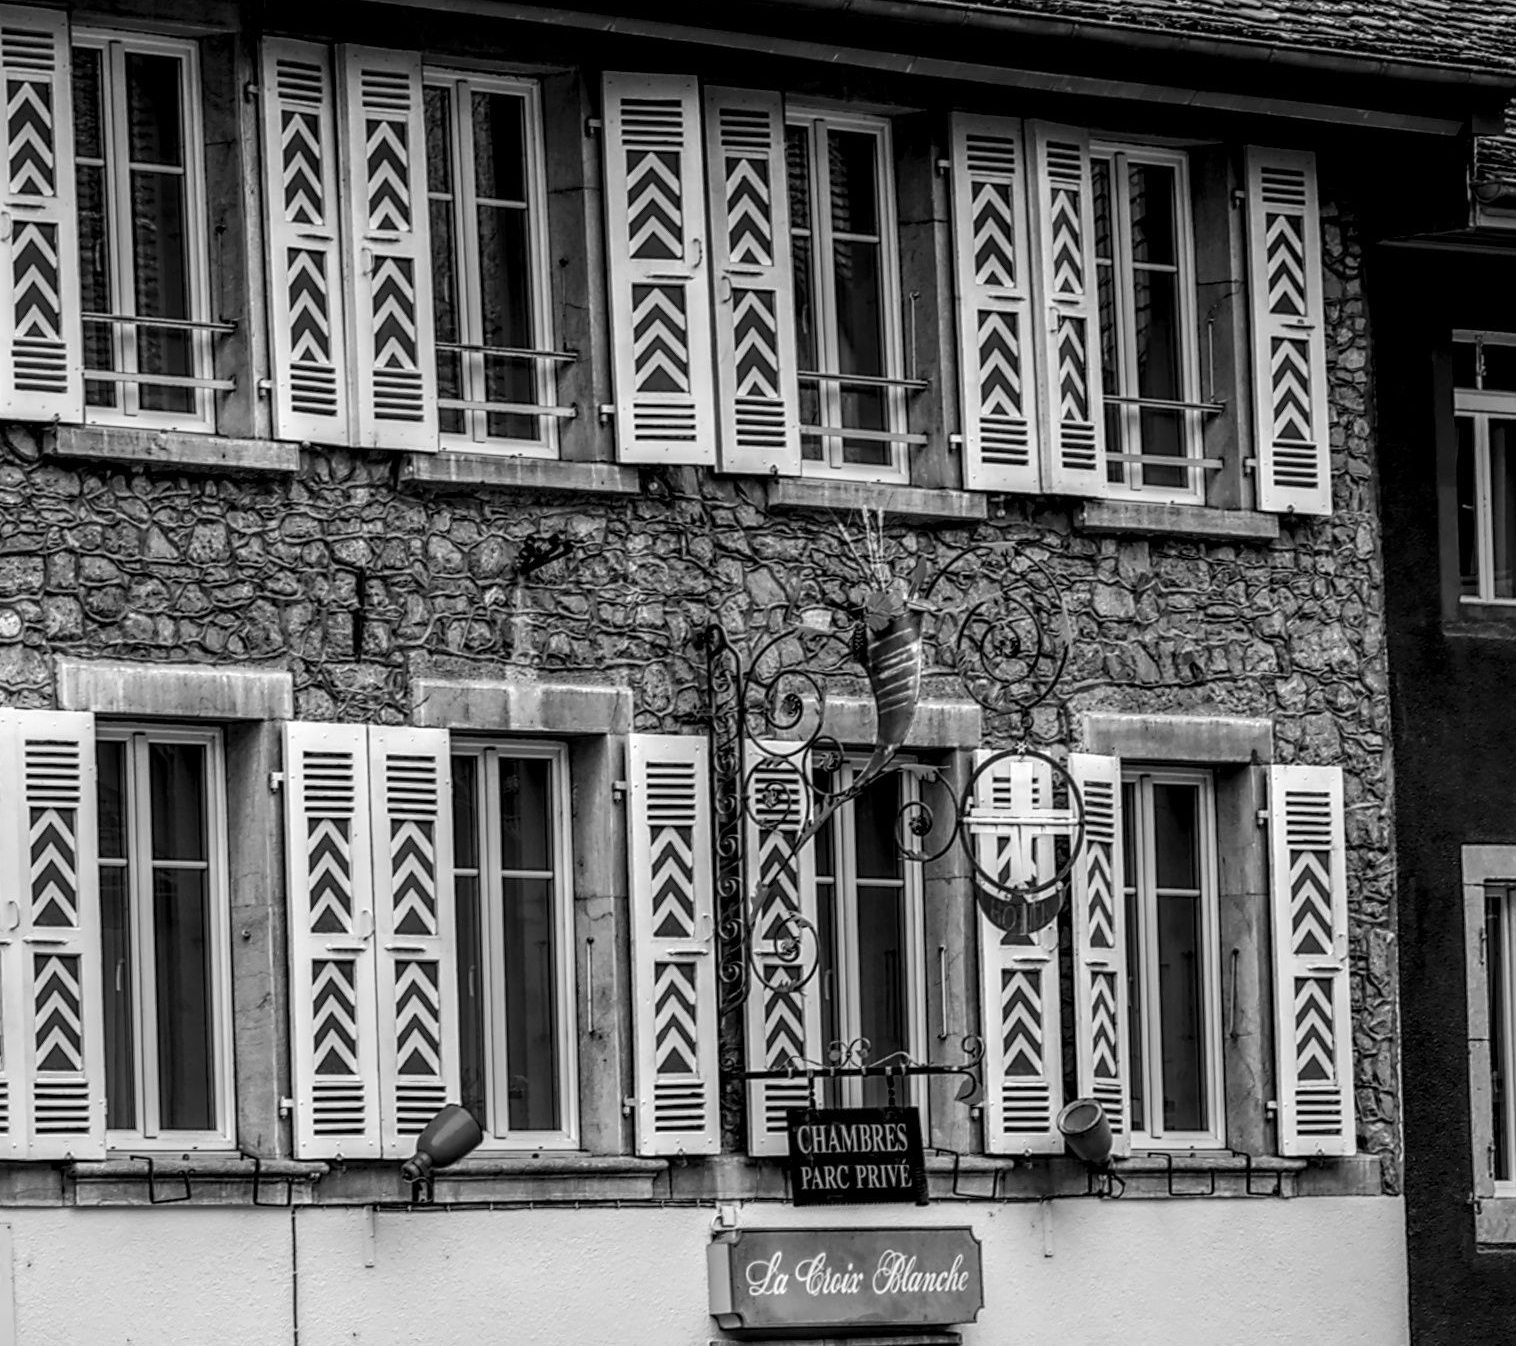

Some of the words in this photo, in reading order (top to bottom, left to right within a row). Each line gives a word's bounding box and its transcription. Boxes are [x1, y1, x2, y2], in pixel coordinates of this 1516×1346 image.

[796, 1123, 908, 1153] CHAMBRES
[800, 1164, 850, 1190] PARC
[854, 1158, 913, 1189] PRIVÉ
[746, 1251, 789, 1296] La
[795, 1252, 864, 1296] Croix
[872, 1249, 969, 1295] Blanche
